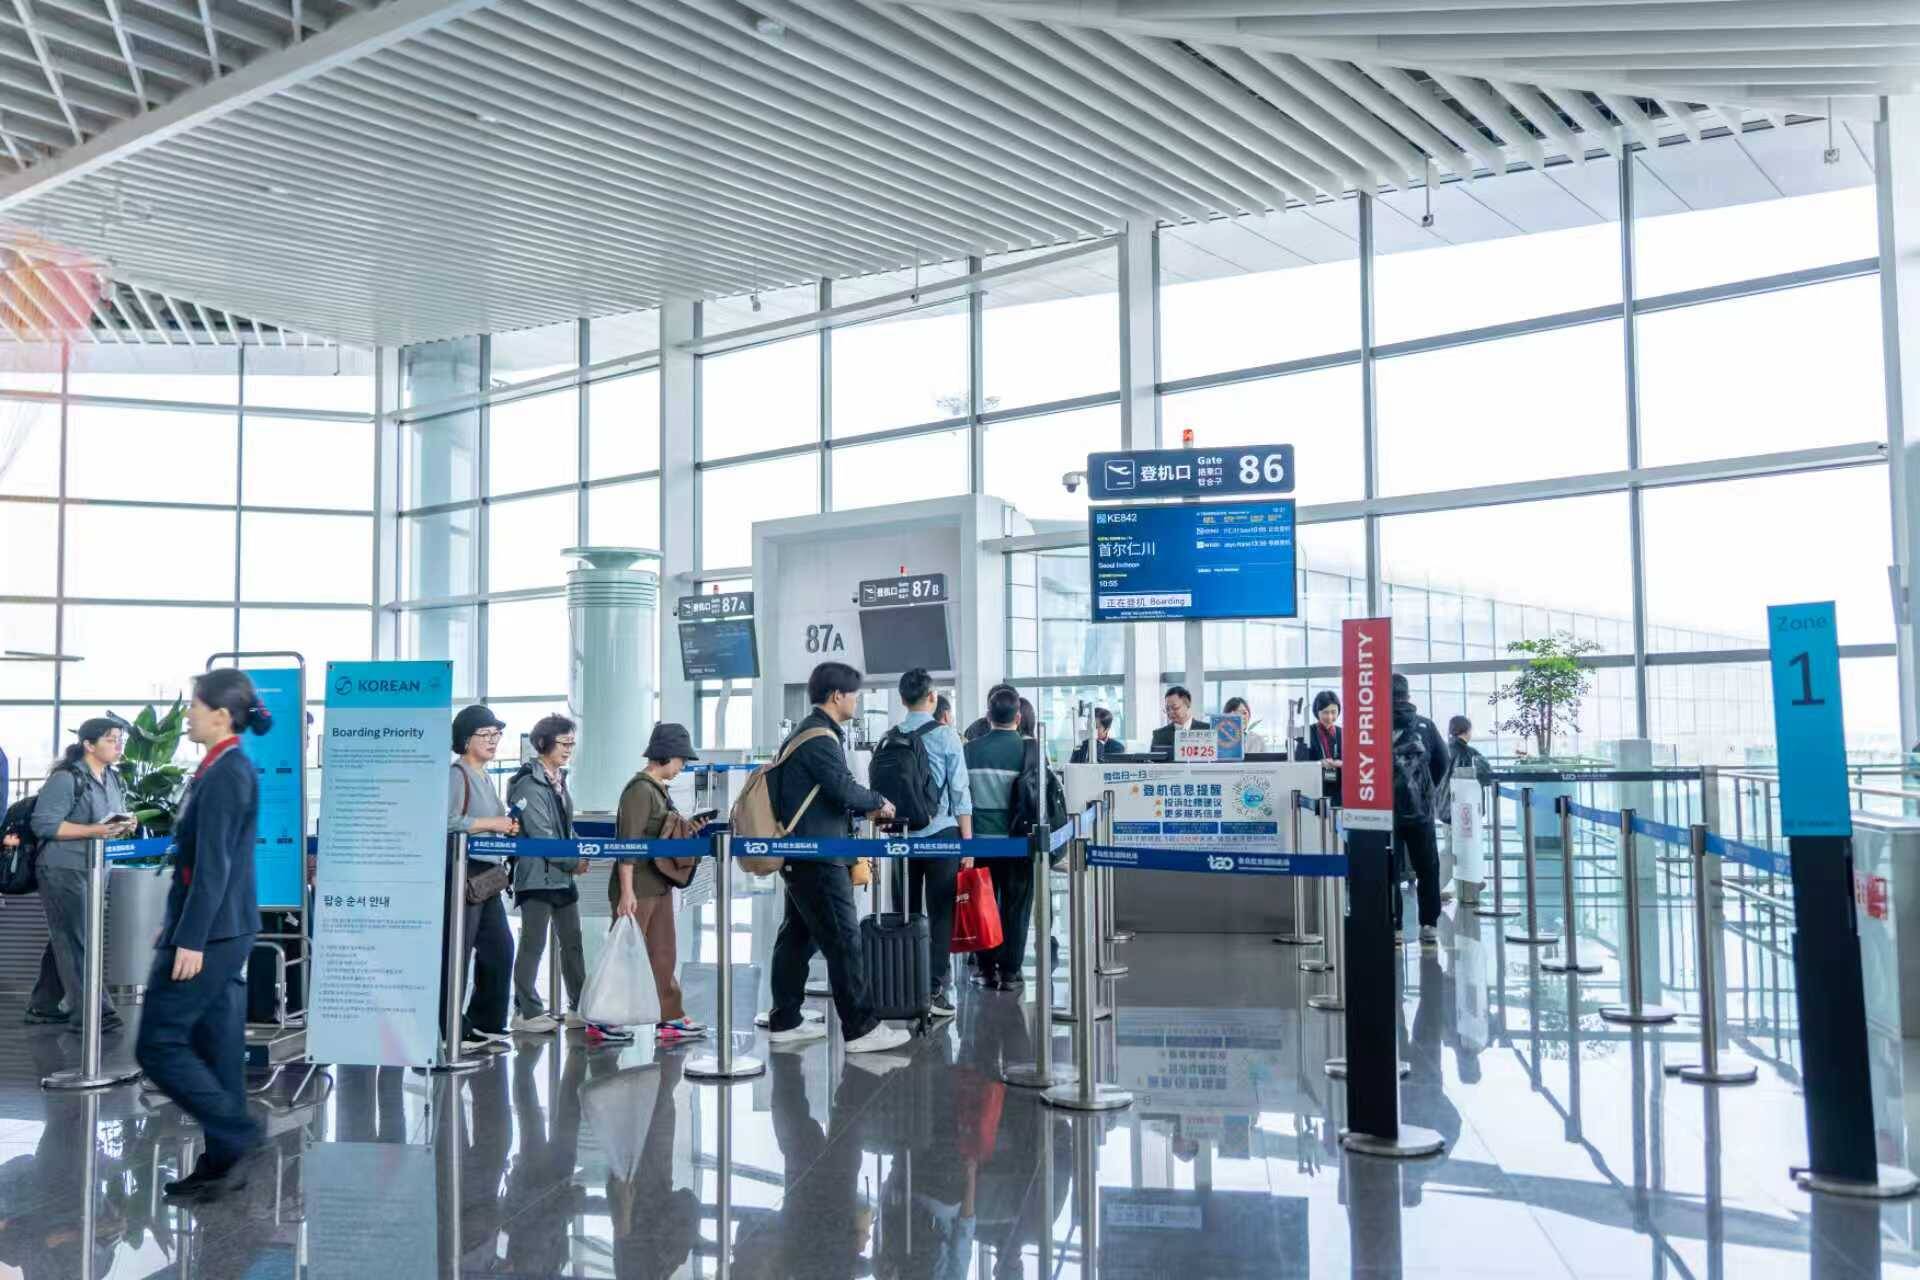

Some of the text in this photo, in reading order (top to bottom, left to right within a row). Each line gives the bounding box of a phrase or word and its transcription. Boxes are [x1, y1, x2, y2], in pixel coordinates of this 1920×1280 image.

[1197, 456, 1223, 465] Gate
[1140, 464, 1191, 482] 登机口
[1238, 454, 1285, 485] 86
[1107, 513, 1137, 523] KE842
[1098, 541, 1156, 557] 首尔仁川
[912, 580, 940, 598] 87B
[722, 596, 747, 613] 87A
[1776, 615, 1828, 633] Zone
[806, 623, 845, 654] 87A
[358, 679, 420, 692] KOREAN
[1789, 651, 1825, 707] 1
[1358, 631, 1375, 746] PRIORITY
[332, 727, 425, 740] Boarding Priority
[1359, 751, 1376, 802] SKY
[1143, 783, 1222, 797] 登机信息提醒
[346, 895, 366, 908] 순서
[369, 895, 391, 909] 안내
